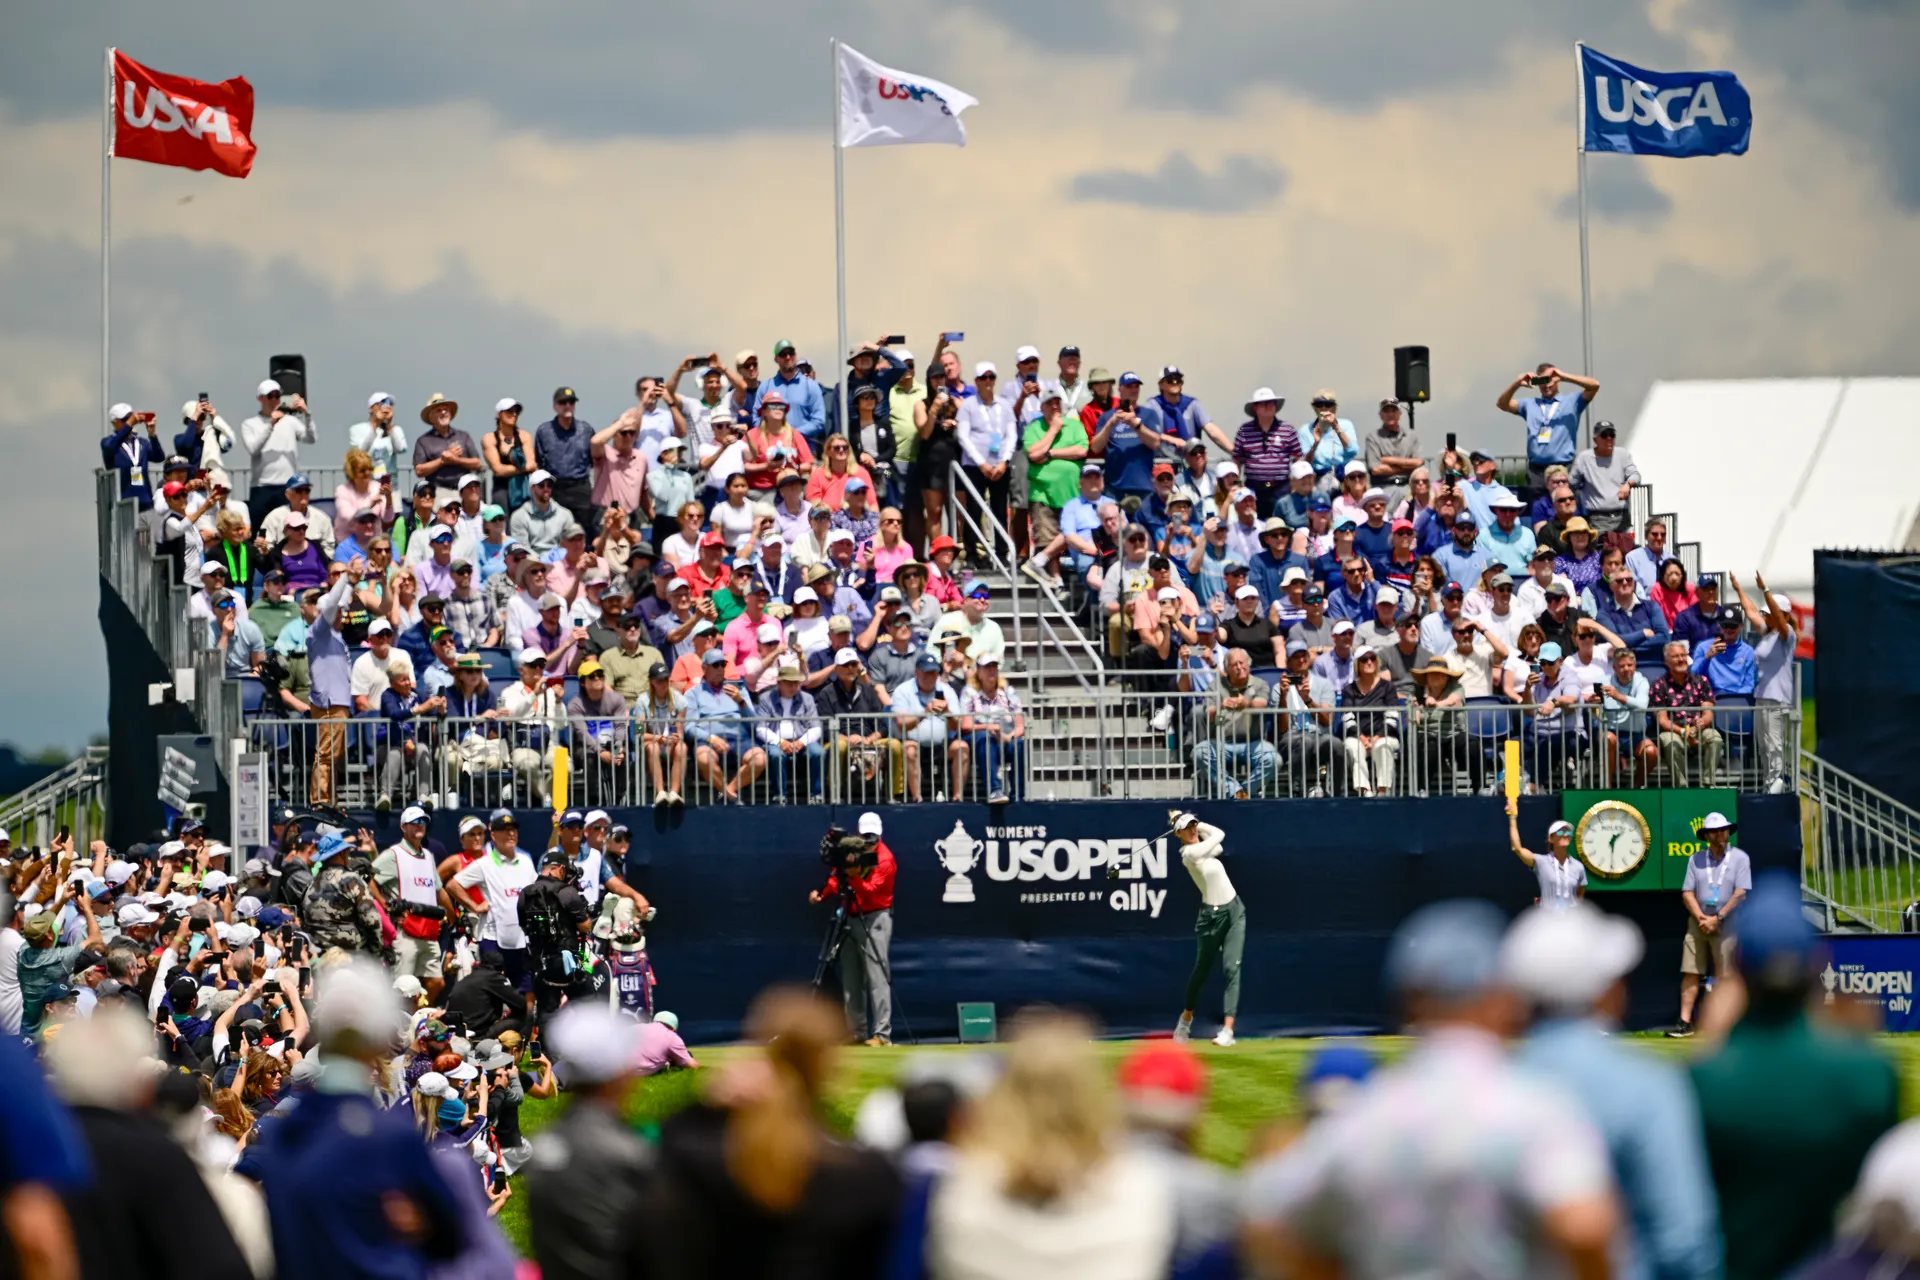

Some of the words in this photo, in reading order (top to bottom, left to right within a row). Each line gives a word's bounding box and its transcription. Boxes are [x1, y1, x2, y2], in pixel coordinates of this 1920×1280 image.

[1595, 76, 1728, 131] USGA
[986, 826, 1046, 838] WOMEN'S
[1668, 842, 1711, 856] ROL
[1020, 892, 1085, 903] PRESENTED
[1089, 891, 1103, 900] BY
[1110, 883, 1167, 918] ally
[1889, 996, 1912, 1015] ally
